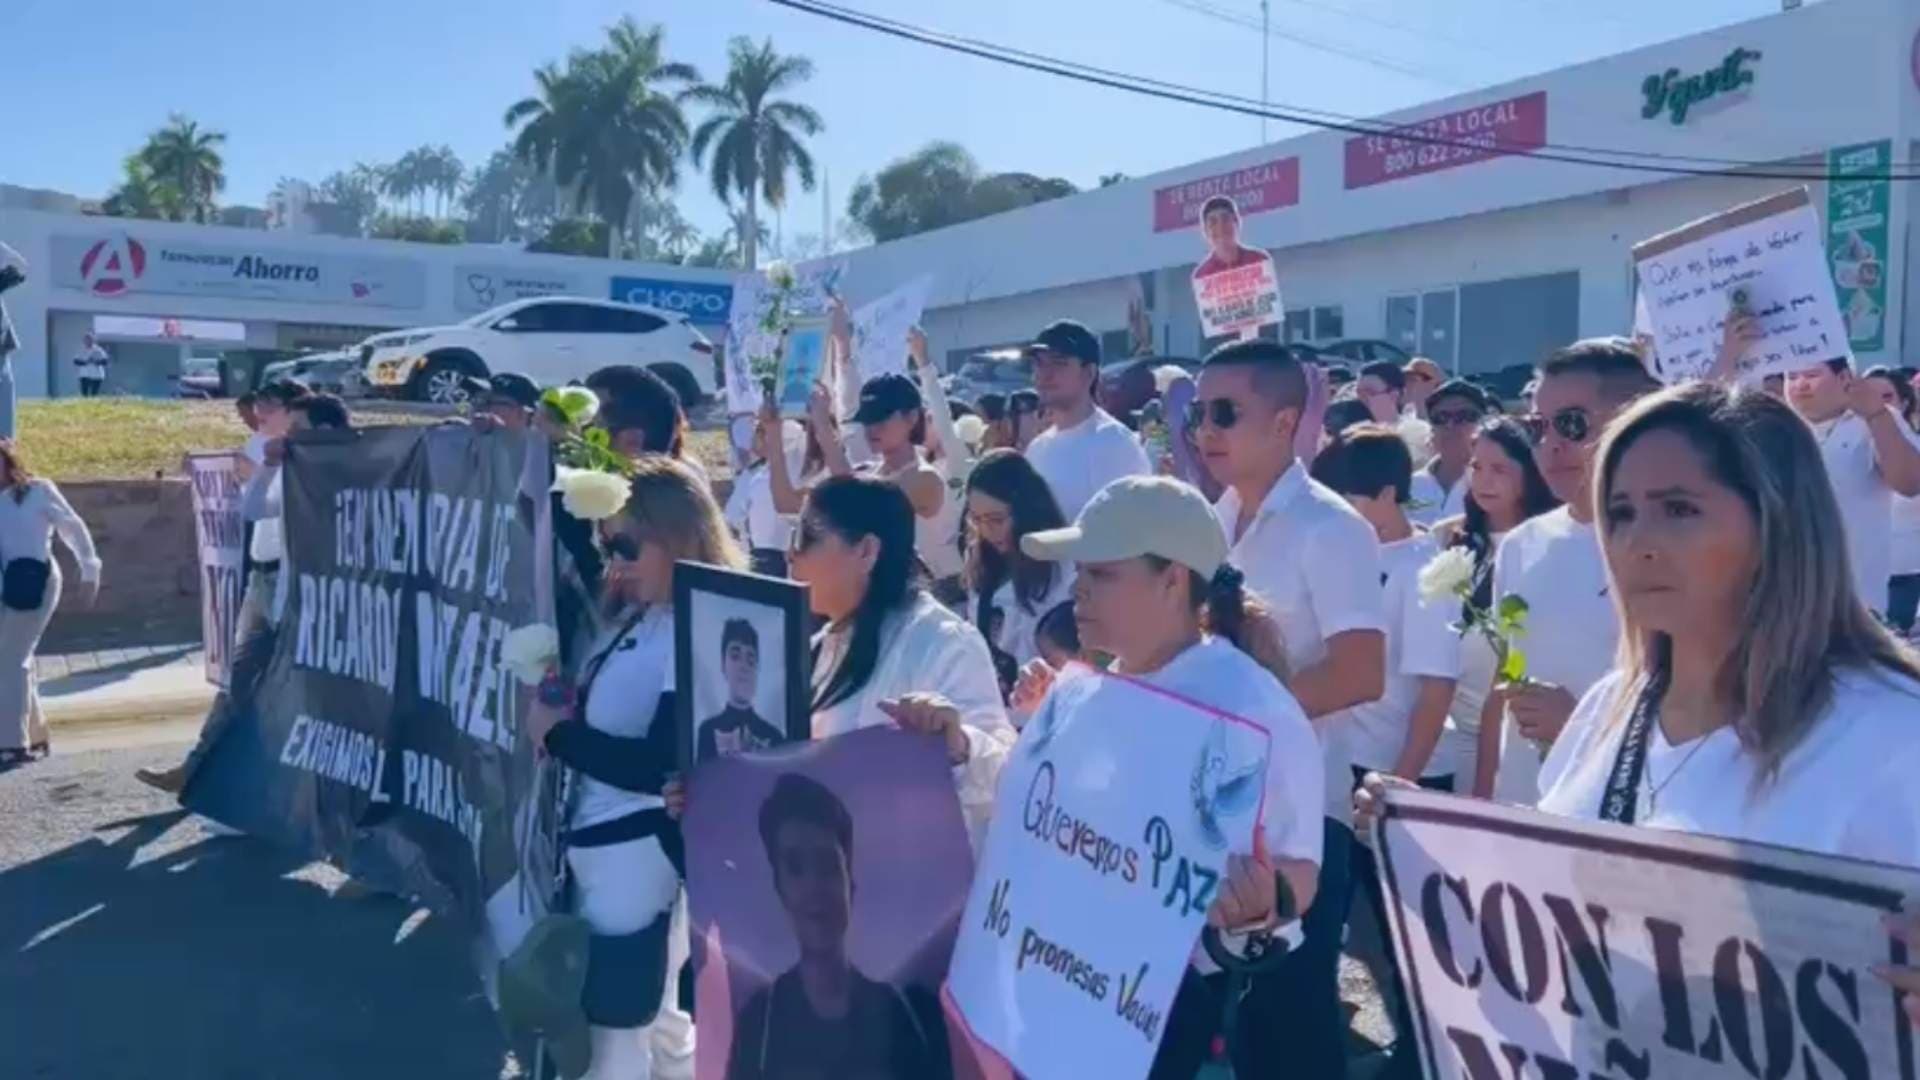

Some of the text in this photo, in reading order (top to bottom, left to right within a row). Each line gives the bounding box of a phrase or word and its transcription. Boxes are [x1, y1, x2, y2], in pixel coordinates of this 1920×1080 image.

[1456, 102, 1519, 134] LOCAL
[233, 255, 320, 283] Ahorro
[627, 286, 726, 314] CHOPO
[402, 749, 454, 825] PARA
[1023, 760, 1219, 918] Queremos PAZ
[983, 878, 1011, 939] No
[1016, 926, 1110, 1003] promesas
[1421, 871, 1872, 1080] CON LOS
